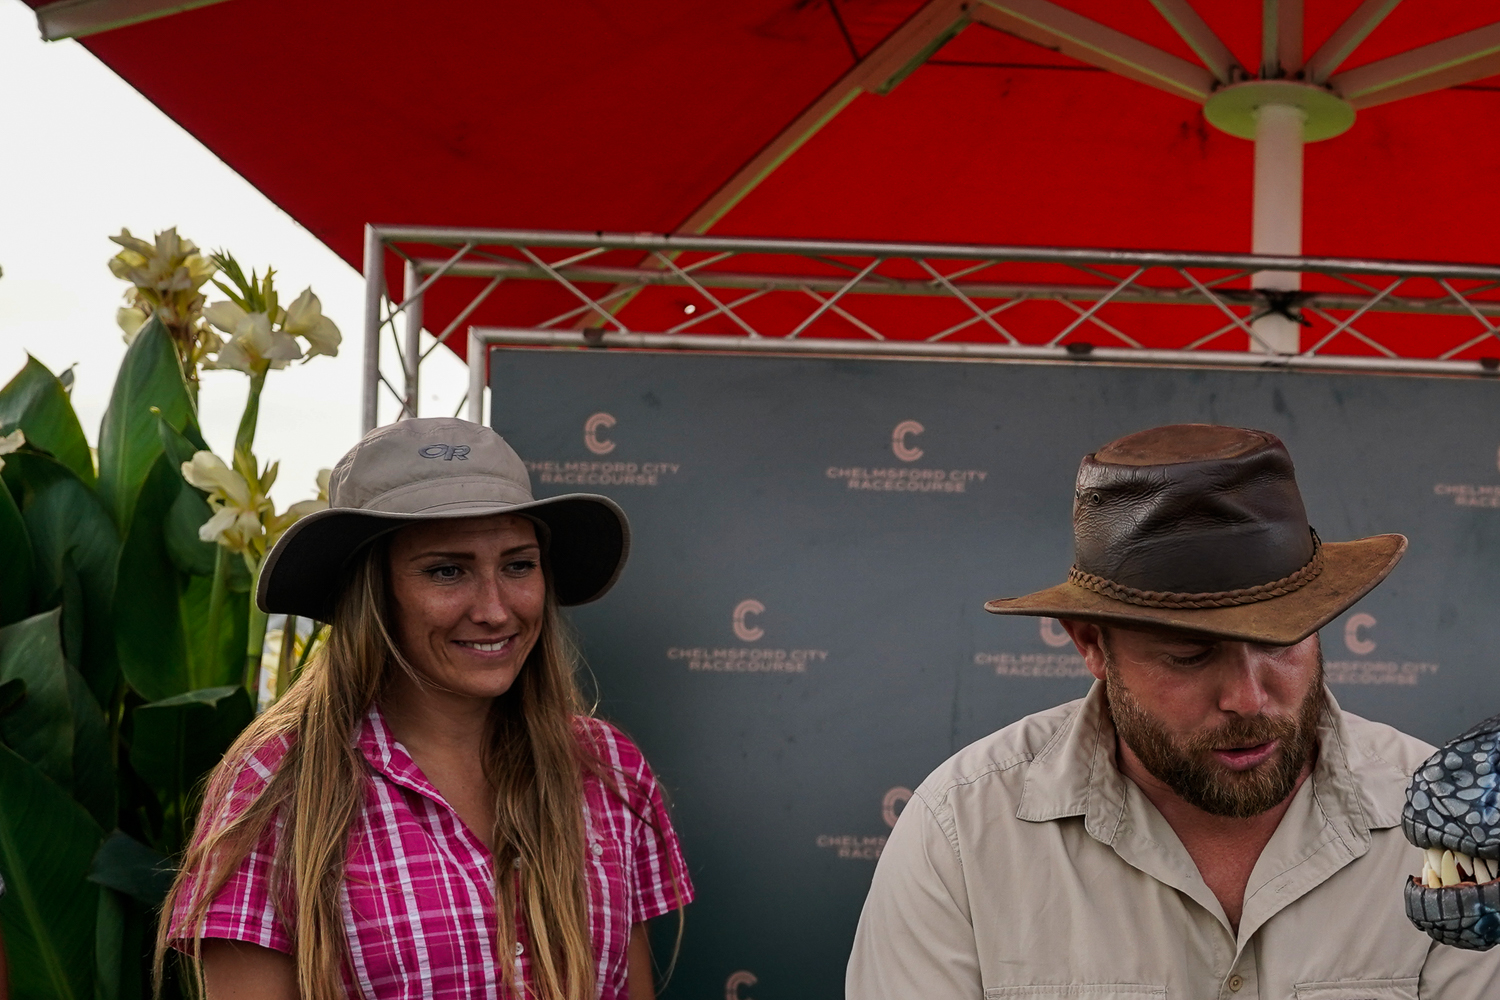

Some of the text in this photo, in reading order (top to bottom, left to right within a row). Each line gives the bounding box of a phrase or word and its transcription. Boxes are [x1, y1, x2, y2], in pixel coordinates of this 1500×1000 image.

[418, 443, 471, 461] OR
[642, 463, 680, 474] CITY
[826, 467, 988, 482] CHELMSFORD CITY
[540, 473, 658, 486] RACECOURSE
[848, 480, 966, 492] RACECOURSE
[666, 648, 828, 661] CHELMSFORD CITY
[689, 661, 806, 673] RACECOURSE
